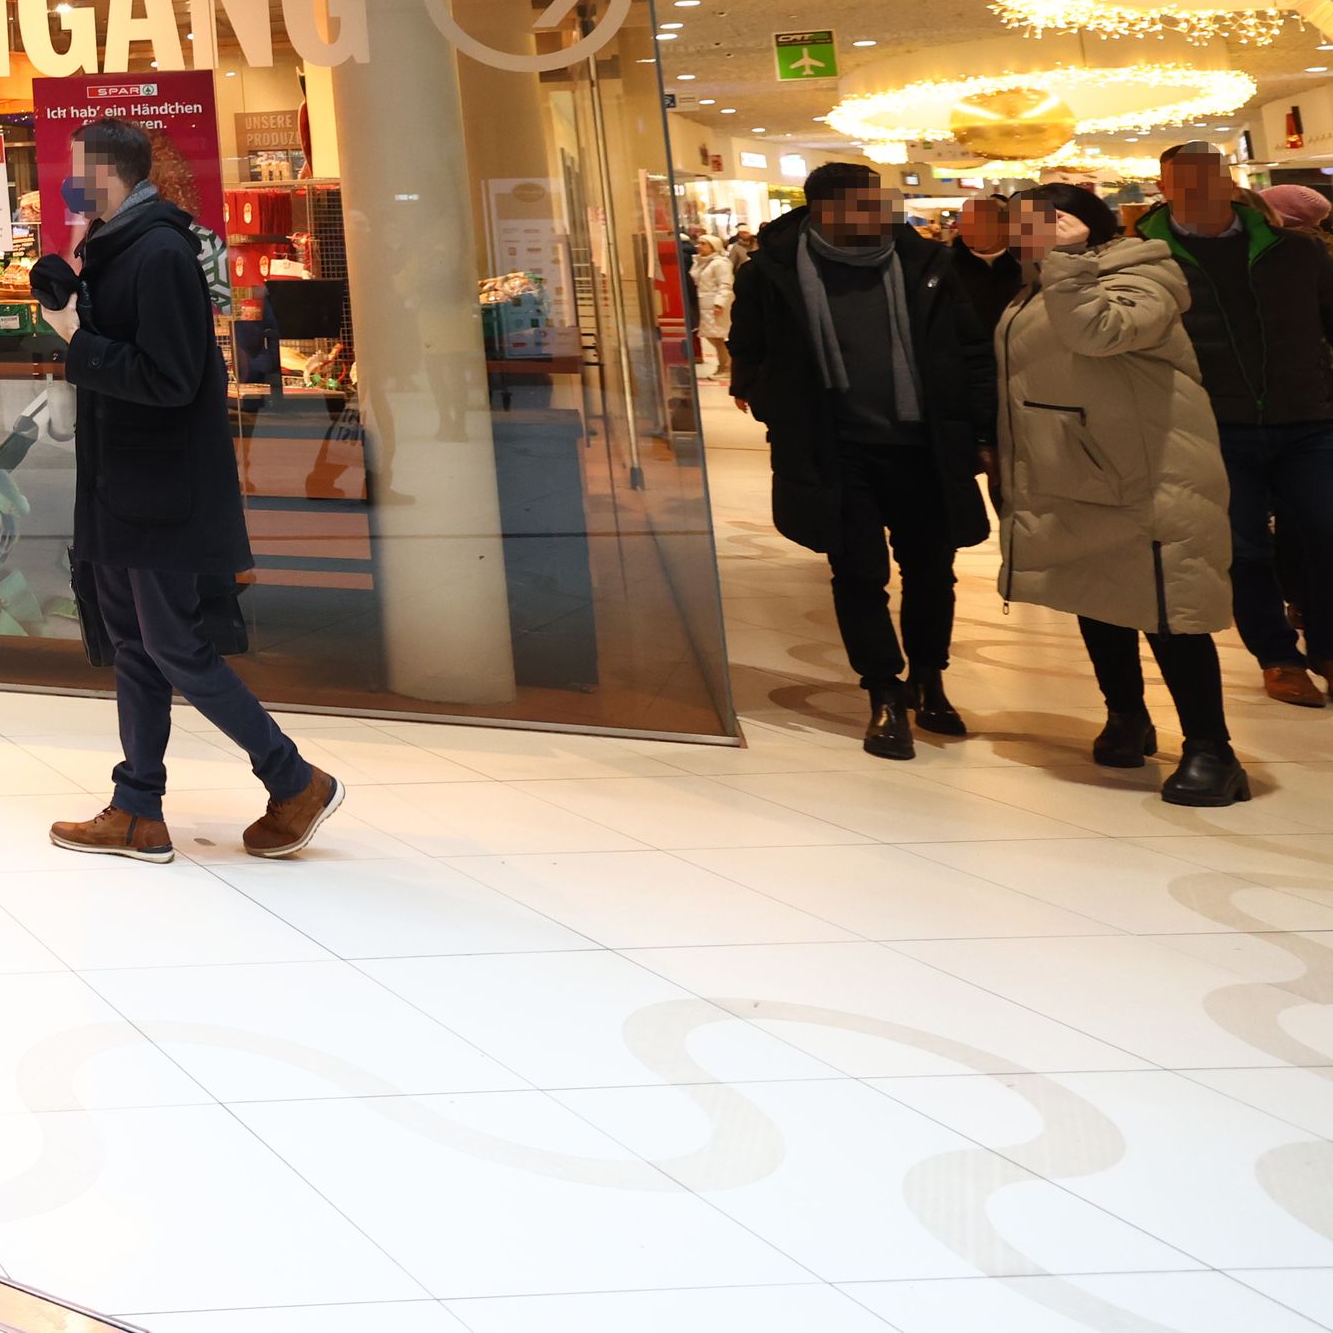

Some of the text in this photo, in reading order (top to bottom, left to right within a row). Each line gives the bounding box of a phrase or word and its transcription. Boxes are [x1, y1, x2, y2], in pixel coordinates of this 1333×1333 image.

[97, 87, 140, 96] SPAR
[46, 107, 67, 119] Ich
[104, 106, 126, 117] ein
[130, 102, 202, 116] Händchen
[245, 114, 292, 130] UNSERE
